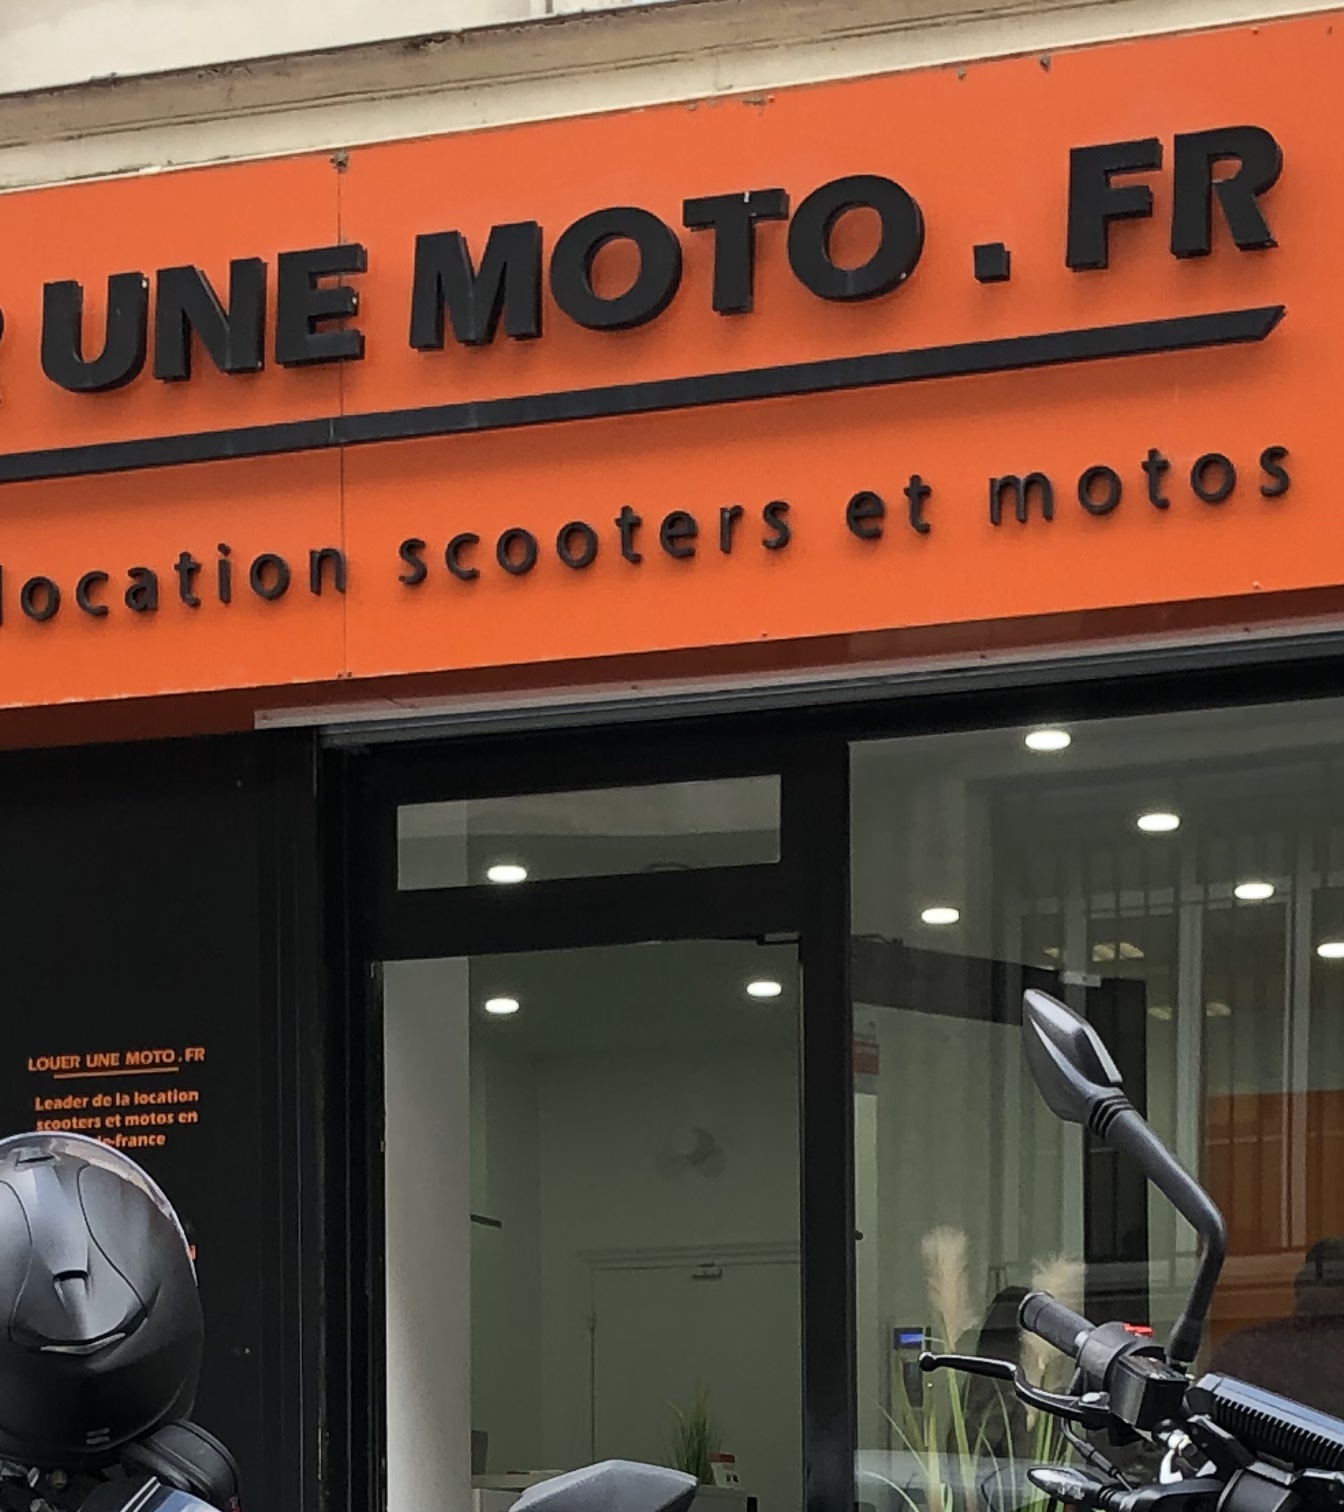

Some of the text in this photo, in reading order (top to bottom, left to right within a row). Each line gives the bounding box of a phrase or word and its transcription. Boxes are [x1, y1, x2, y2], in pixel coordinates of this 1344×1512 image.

[41, 243, 369, 394] UNE
[409, 174, 925, 352] MOTO
[1065, 125, 1285, 273] FR
[398, 503, 793, 588] scooters
[845, 474, 932, 542] et
[988, 444, 1292, 528] motos
[27, 1053, 80, 1072] LOUER
[85, 1052, 120, 1068] UNE
[125, 1049, 176, 1066] MOTO
[184, 1046, 206, 1062] FR
[34, 1088, 199, 1111] Leader de la location
[36, 1110, 199, 1132] scooters et motos en
